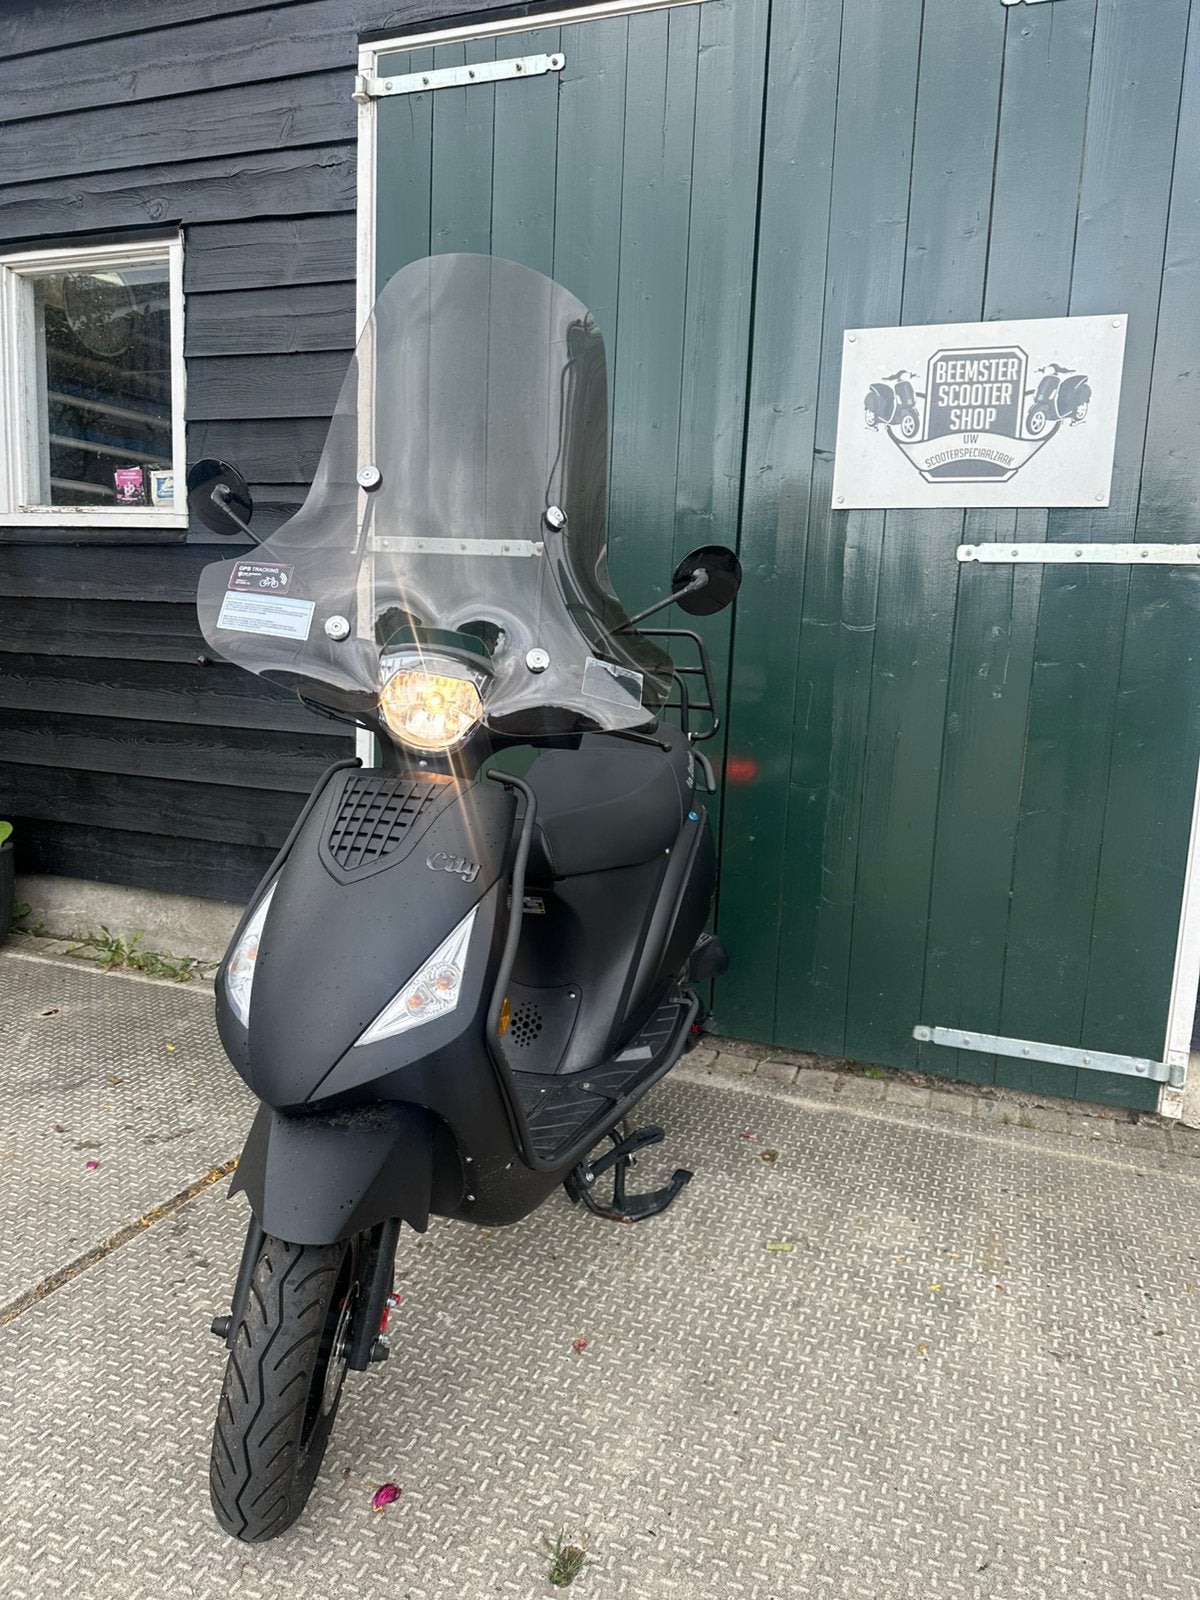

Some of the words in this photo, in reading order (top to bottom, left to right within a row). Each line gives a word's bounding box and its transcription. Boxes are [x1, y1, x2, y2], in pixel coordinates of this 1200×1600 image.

[936, 358, 1018, 383] BEEMSTER
[938, 383, 1012, 407] SCOOTER
[949, 407, 997, 431] SHOP
[963, 434, 979, 444] UW
[925, 447, 1015, 468] SCOOTERSPECIAALZAAK
[426, 852, 482, 882] City
